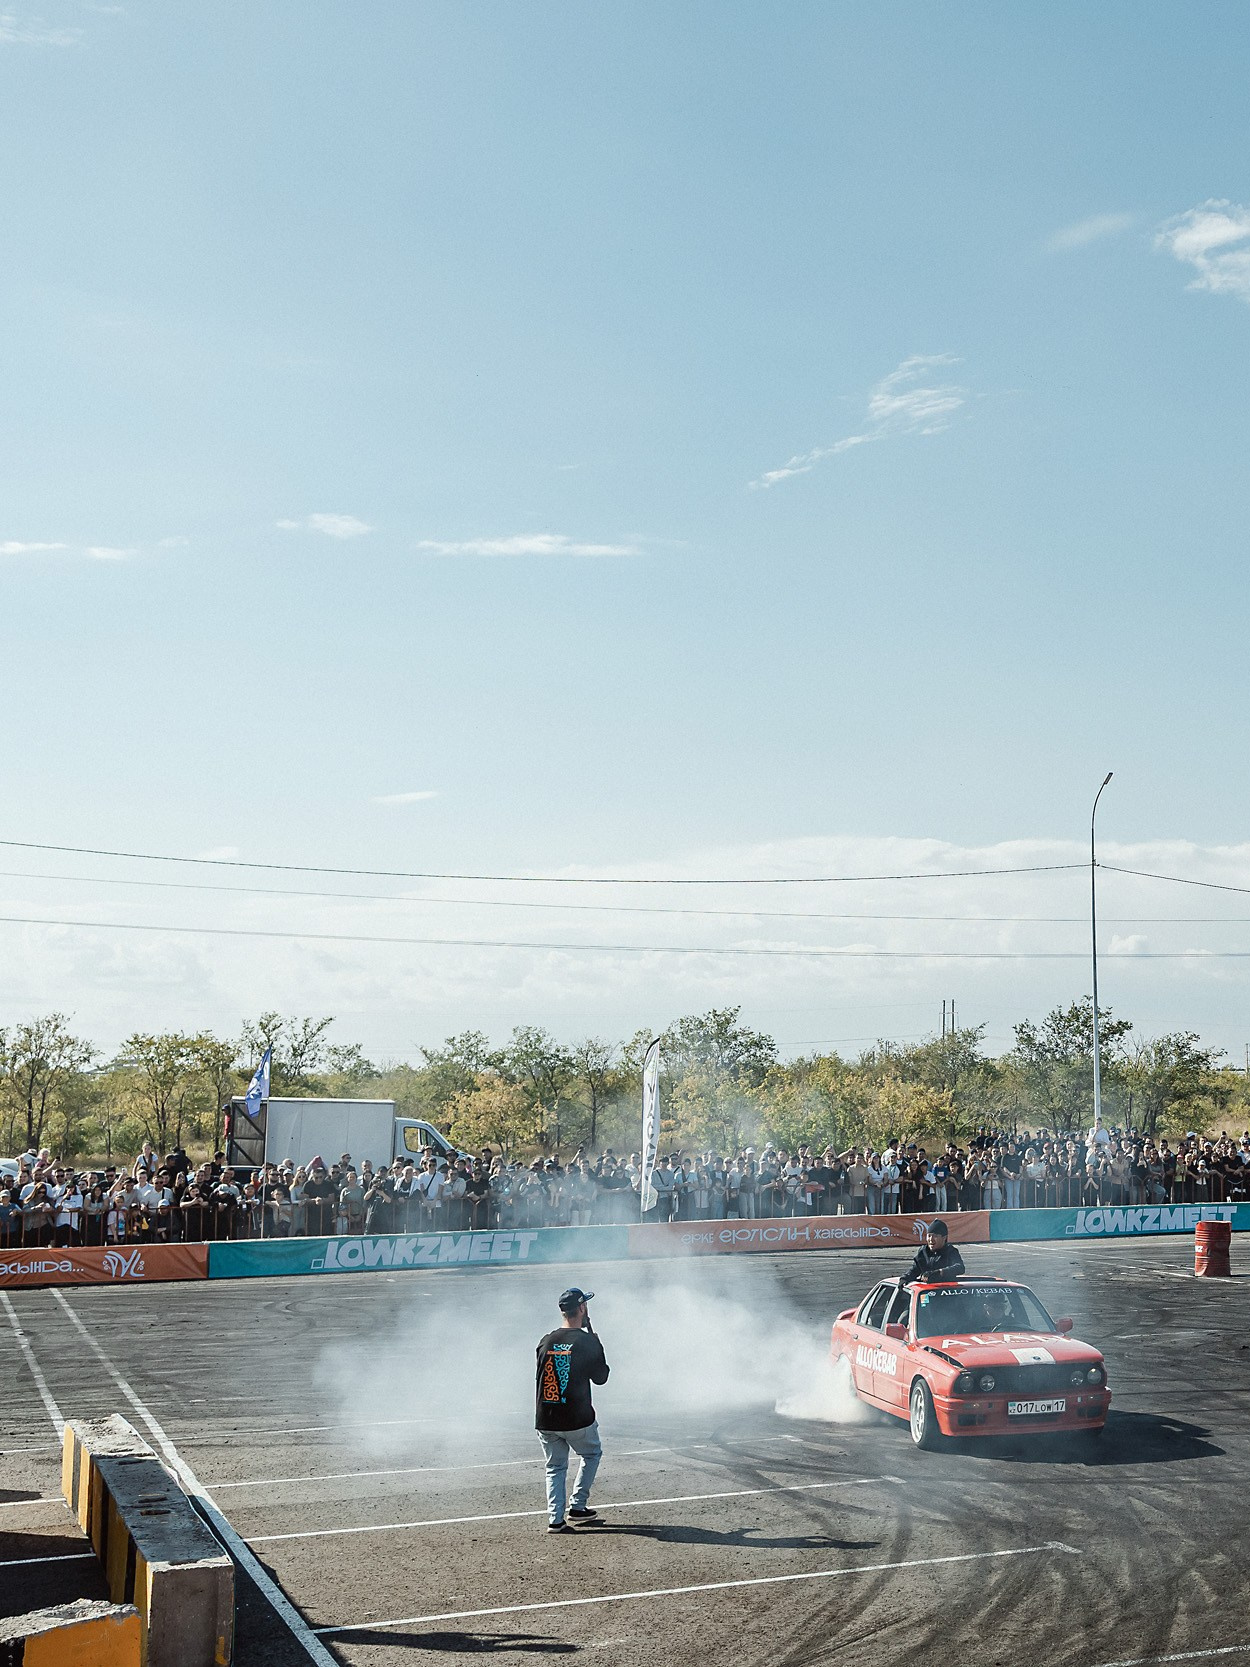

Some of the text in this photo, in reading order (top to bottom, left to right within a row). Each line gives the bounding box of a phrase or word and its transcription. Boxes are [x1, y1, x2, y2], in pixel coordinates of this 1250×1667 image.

[323, 1232, 539, 1269] LOWKZMEET
[940, 1288, 969, 1296] ALLO
[856, 1344, 873, 1370] ALLO
